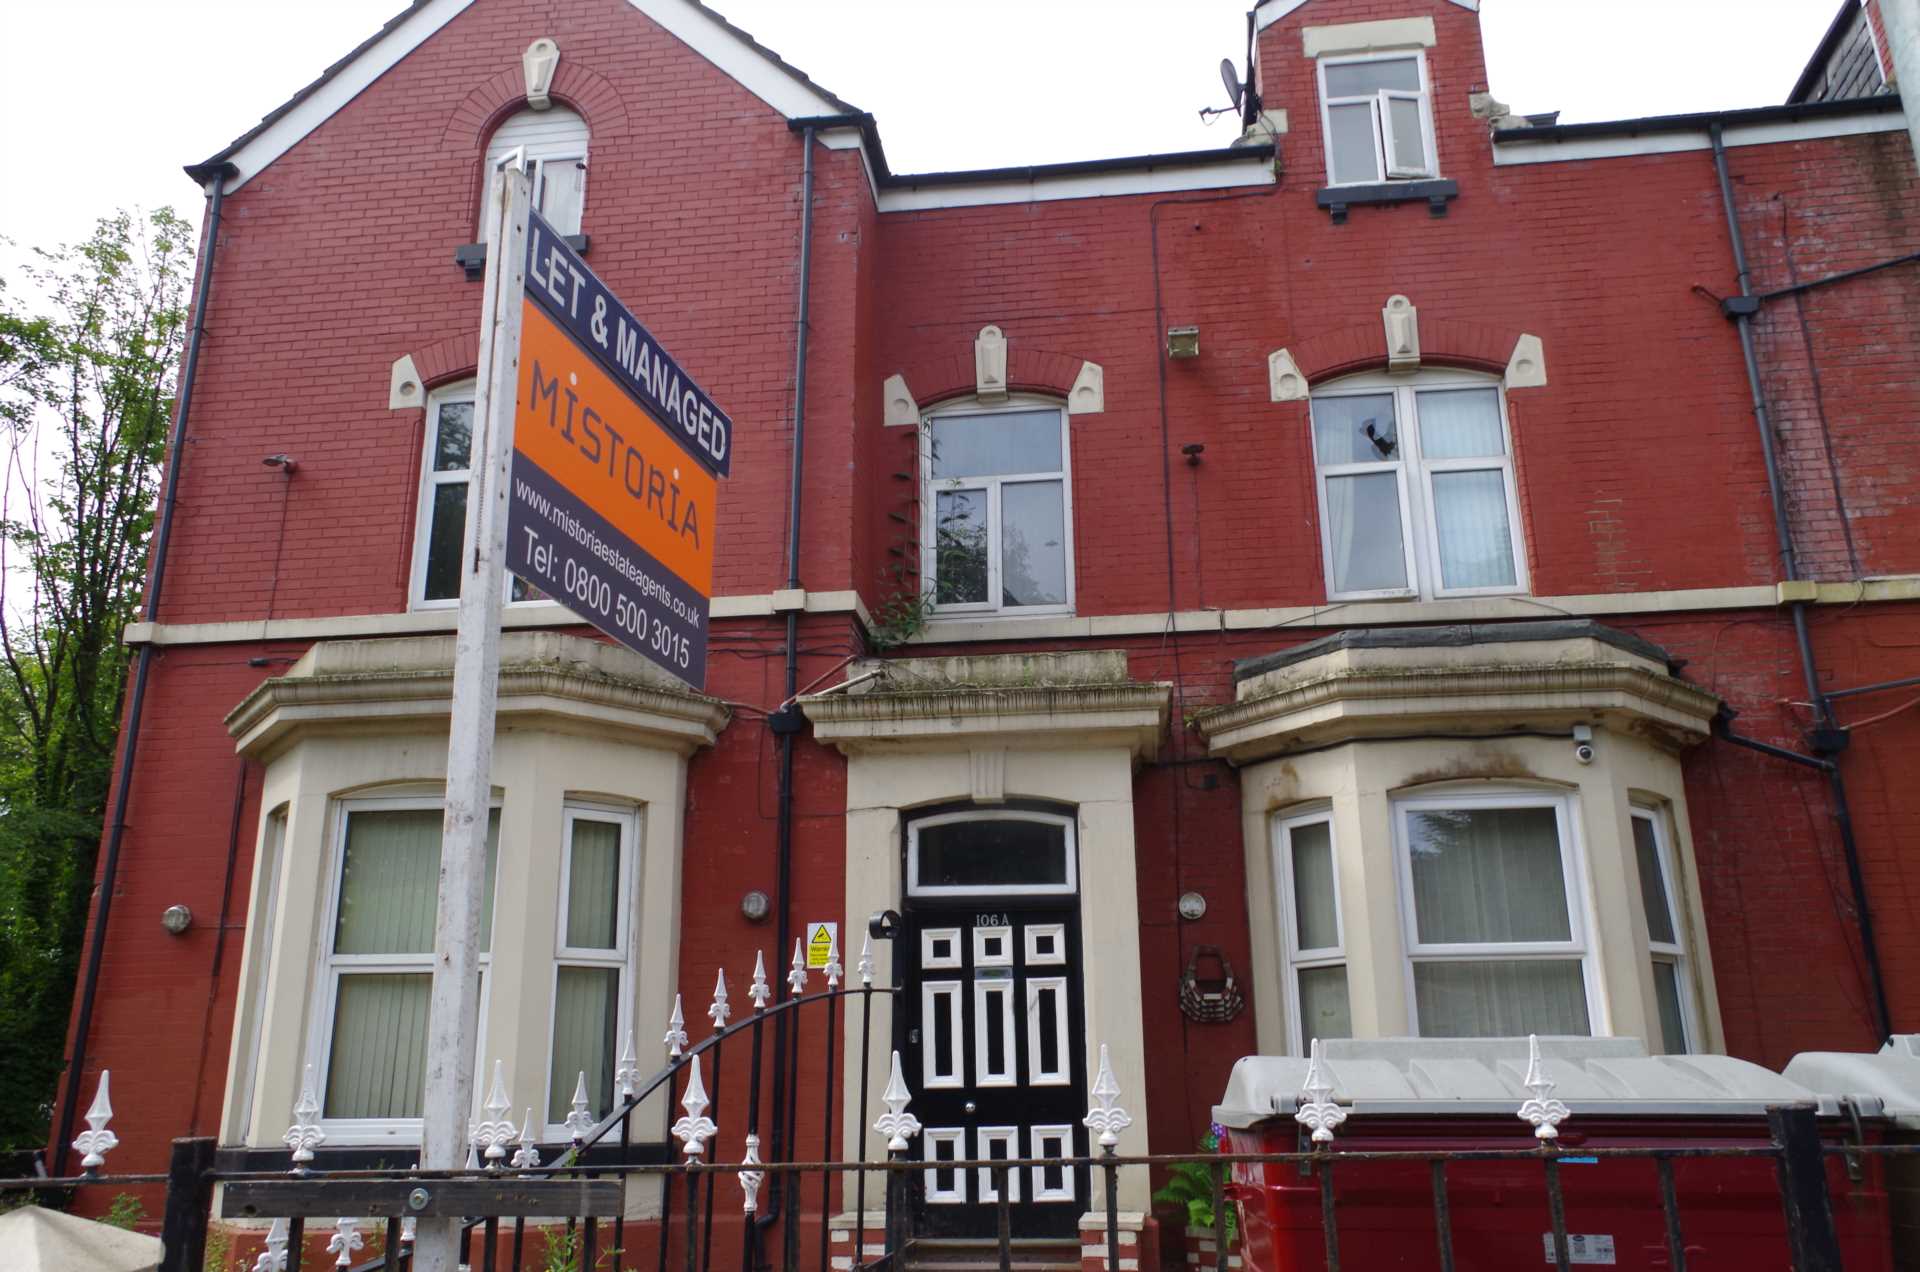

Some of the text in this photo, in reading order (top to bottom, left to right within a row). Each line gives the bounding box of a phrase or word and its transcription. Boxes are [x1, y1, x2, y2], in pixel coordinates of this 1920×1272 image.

[530, 228, 726, 462] LET & MANAGED
[516, 478, 699, 628] www.mistoriaestateagents.co.uk
[524, 526, 690, 669] Tel: 0800 500 3015
